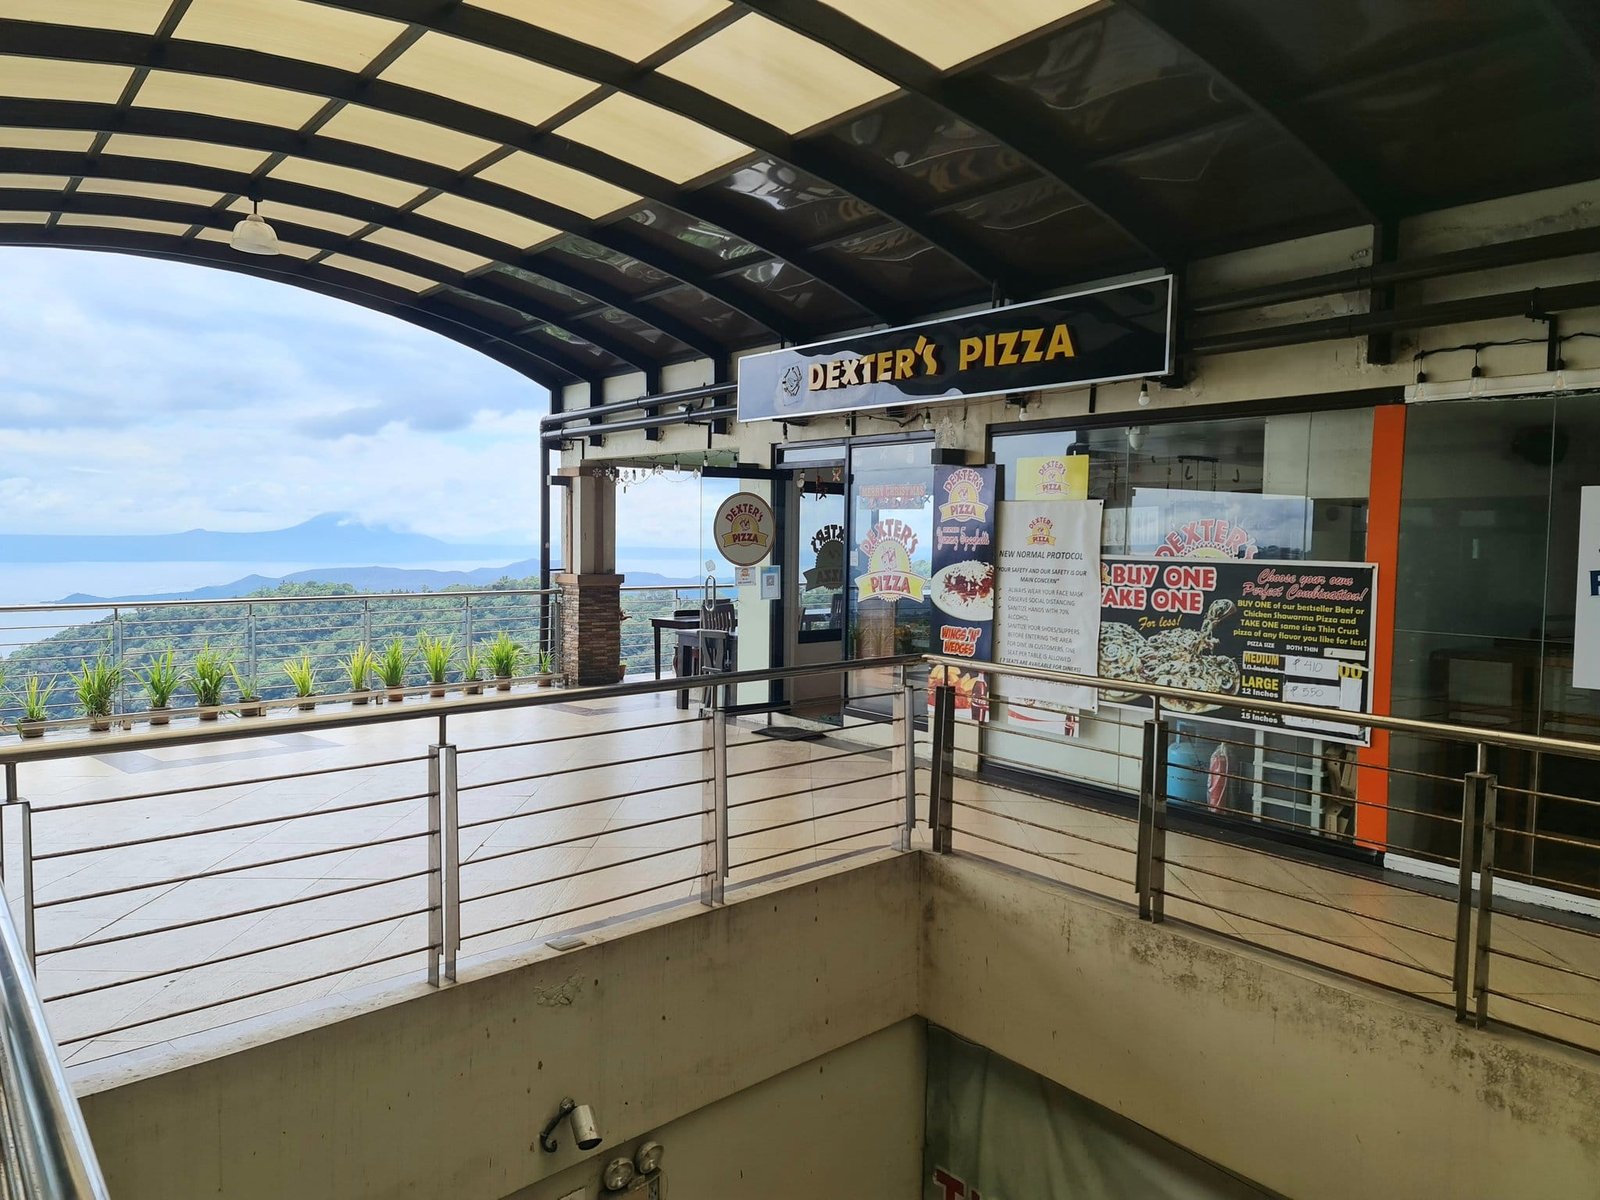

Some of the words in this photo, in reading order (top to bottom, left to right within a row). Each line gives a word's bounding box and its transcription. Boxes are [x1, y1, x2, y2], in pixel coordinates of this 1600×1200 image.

[808, 335, 938, 391] DEXTER'S
[959, 324, 1075, 371] PIZZA
[944, 468, 984, 492] DEXTER'S
[1042, 484, 1062, 492] PIZZA
[725, 503, 764, 523] DEXTER'S
[950, 504, 977, 516] PIZZA
[1028, 516, 1053, 530] DEXTER'S
[732, 533, 759, 543] PIZZA
[860, 519, 918, 556] DEXTER'S
[1032, 536, 1050, 544] PIZZA
[998, 550, 1015, 558] NEW
[1016, 551, 1045, 559] NORMAL
[1046, 552, 1083, 560] PROTOCOL
[870, 575, 911, 594] PIZZA
[1112, 565, 1158, 586] BUY
[1165, 567, 1216, 590] ONE
[1257, 568, 1297, 584] Choose
[1299, 575, 1326, 588] your
[1329, 577, 1354, 586] own
[1242, 582, 1284, 600] Perfect
[1045, 598, 1076, 606] DISTANCING
[1101, 586, 1146, 611] AKE
[1153, 590, 1203, 613] ONE
[1237, 600, 1254, 608] BUY
[1254, 601, 1272, 609] ONE
[1296, 603, 1334, 613] bestseller
[1335, 606, 1354, 614] Beef
[1007, 613, 1028, 621] ALCOHOL
[1139, 616, 1156, 630] For
[1159, 614, 1183, 629] less!
[1243, 610, 1272, 618] Chicken
[1273, 612, 1314, 621] Shawarma
[1316, 615, 1338, 623] Pizza
[942, 626, 967, 641] WINGS
[1240, 619, 1260, 627] TAKE
[1261, 620, 1279, 629] ONE
[1318, 625, 1336, 633] Thin
[1337, 626, 1359, 635] Crust
[1024, 633, 1049, 641] ENTERING
[1262, 632, 1277, 640] any
[1278, 632, 1302, 640] flavor
[1319, 635, 1335, 644] like
[1336, 636, 1348, 645] for
[1350, 638, 1367, 646] less!
[944, 640, 975, 656] WEDGES
[1048, 654, 1072, 663] ALLOWED
[1244, 652, 1280, 666] MEDIUM
[1303, 660, 1323, 673] 410
[1241, 675, 1279, 690] LARGE
[1252, 689, 1279, 699] Inches
[1302, 687, 1324, 698] 550
[1241, 712, 1251, 720] 15
[1252, 713, 1279, 724] Inches
